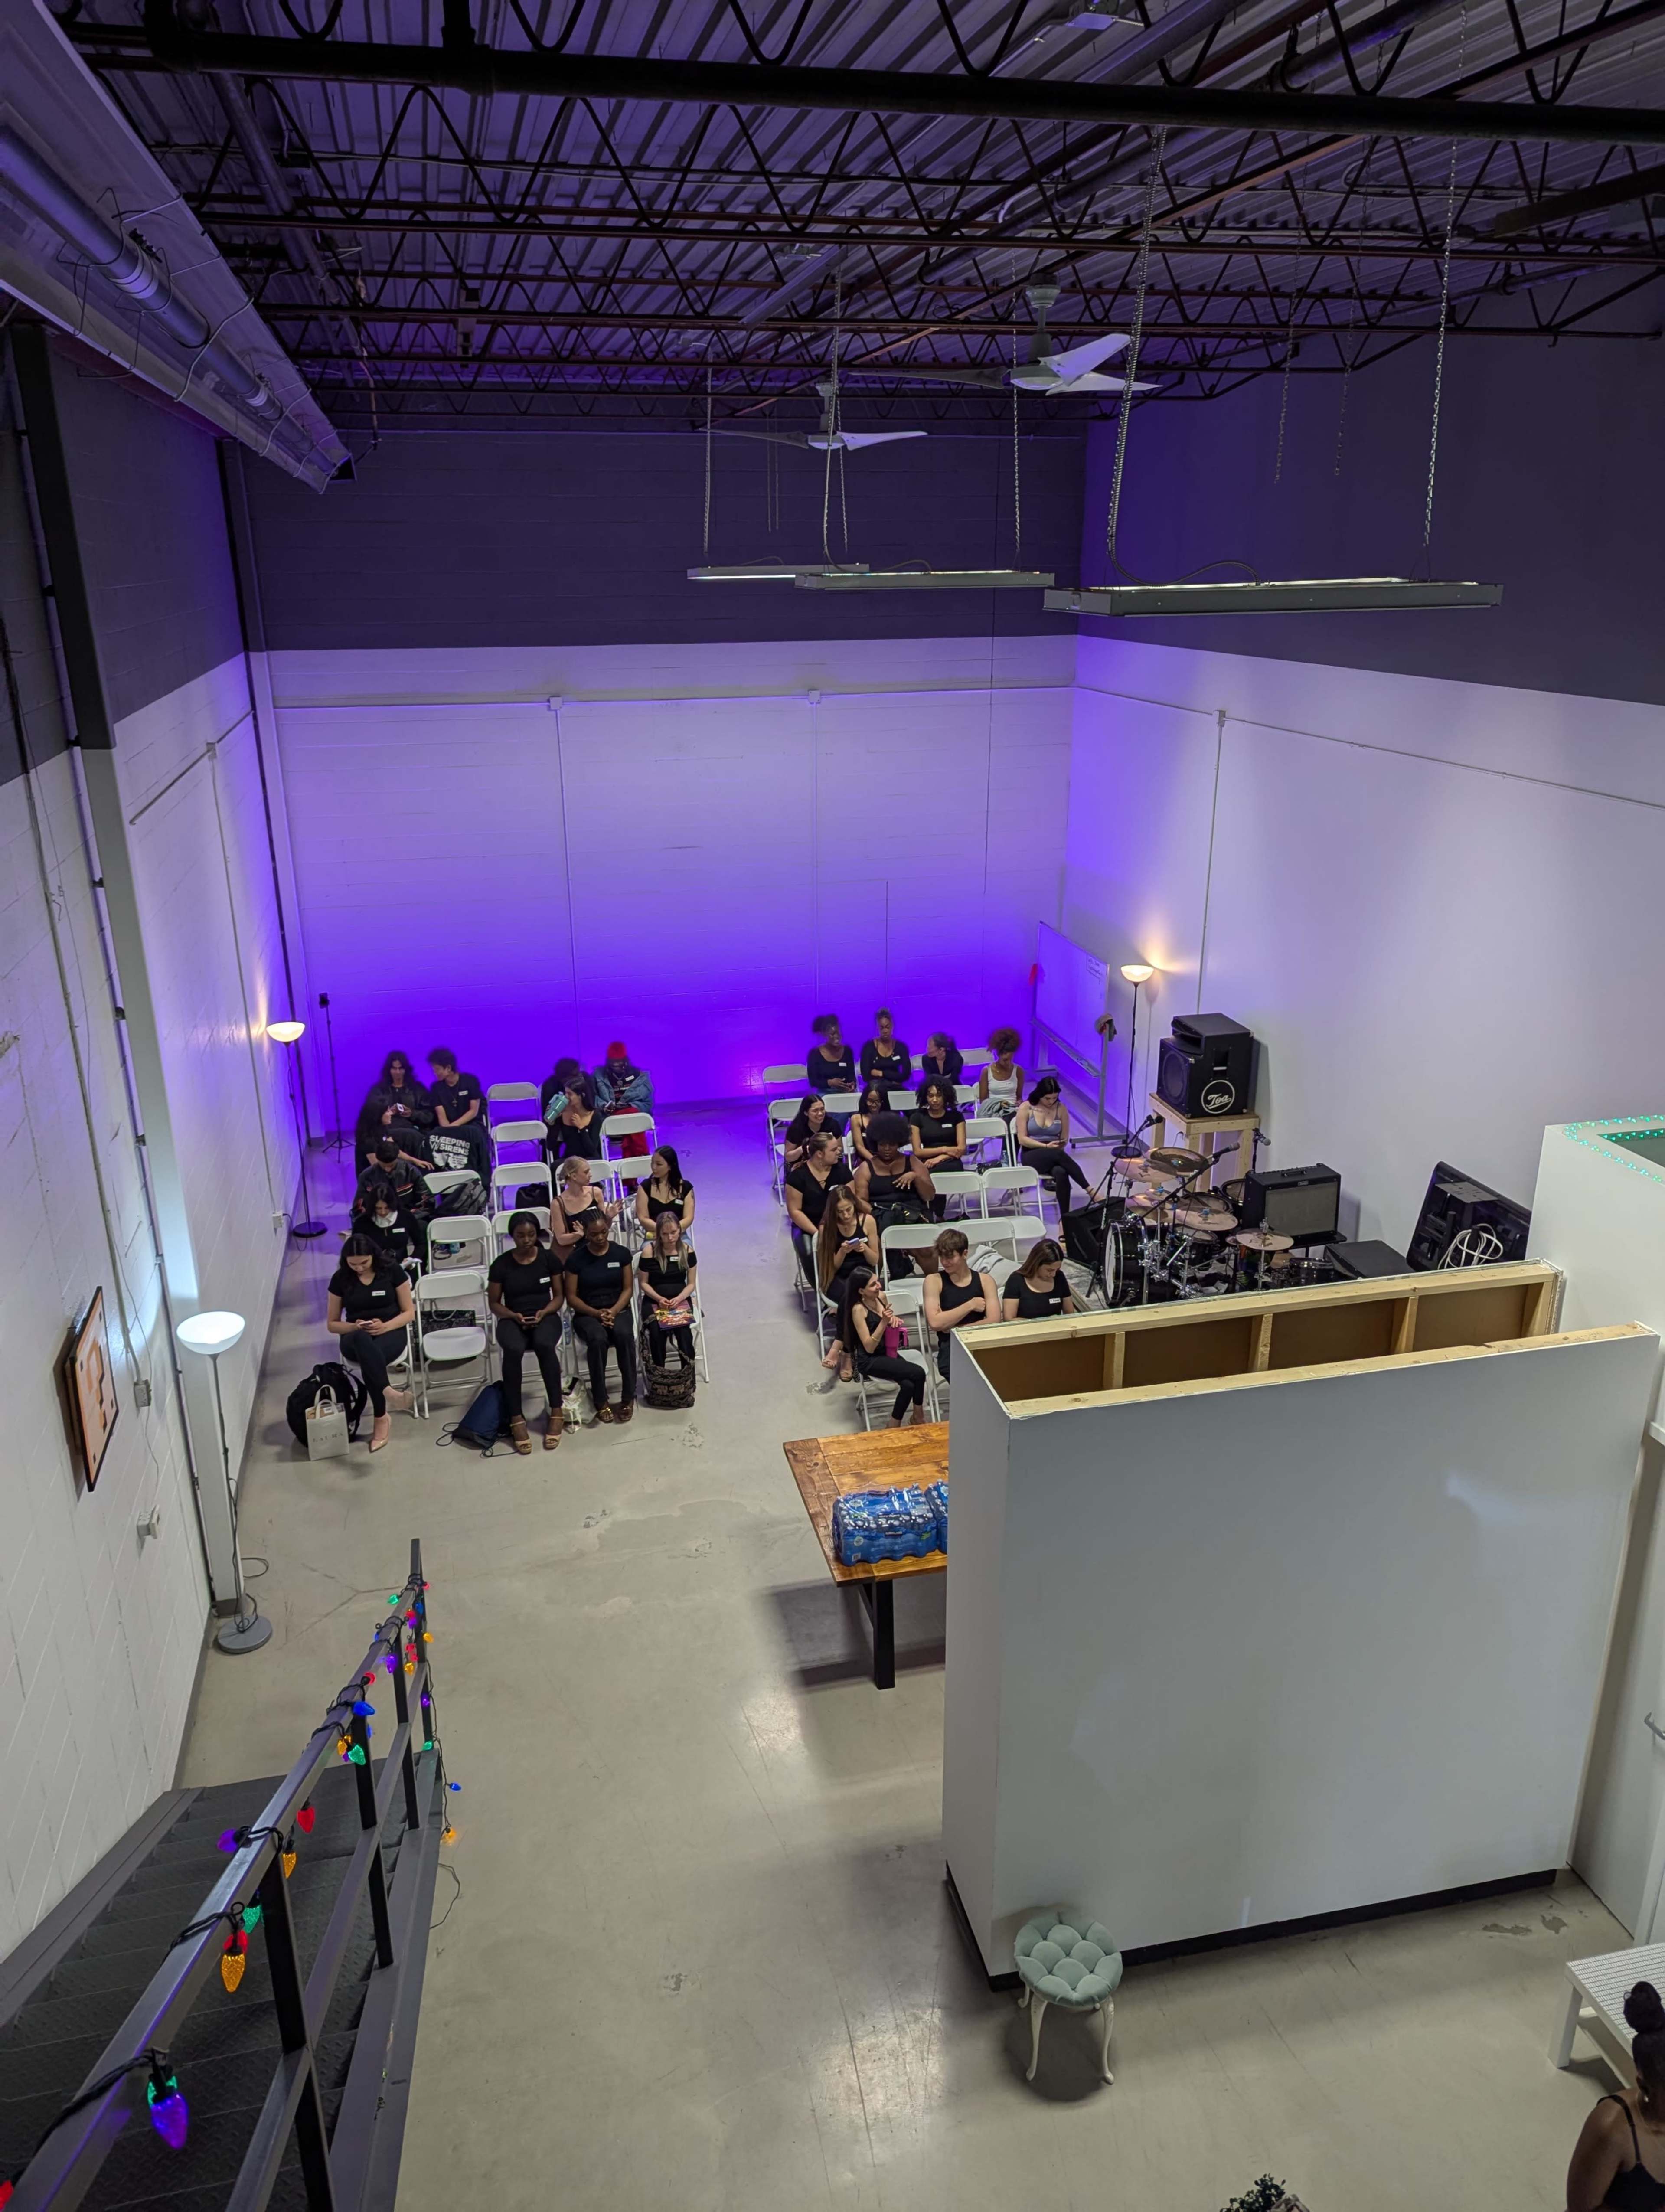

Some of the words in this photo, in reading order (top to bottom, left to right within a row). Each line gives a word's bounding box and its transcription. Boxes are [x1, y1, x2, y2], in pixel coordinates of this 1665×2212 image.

[1205, 1093, 1231, 1109] Toa
[429, 1135, 470, 1149] SLEEPING
[439, 1143, 469, 1156] SIRENS
